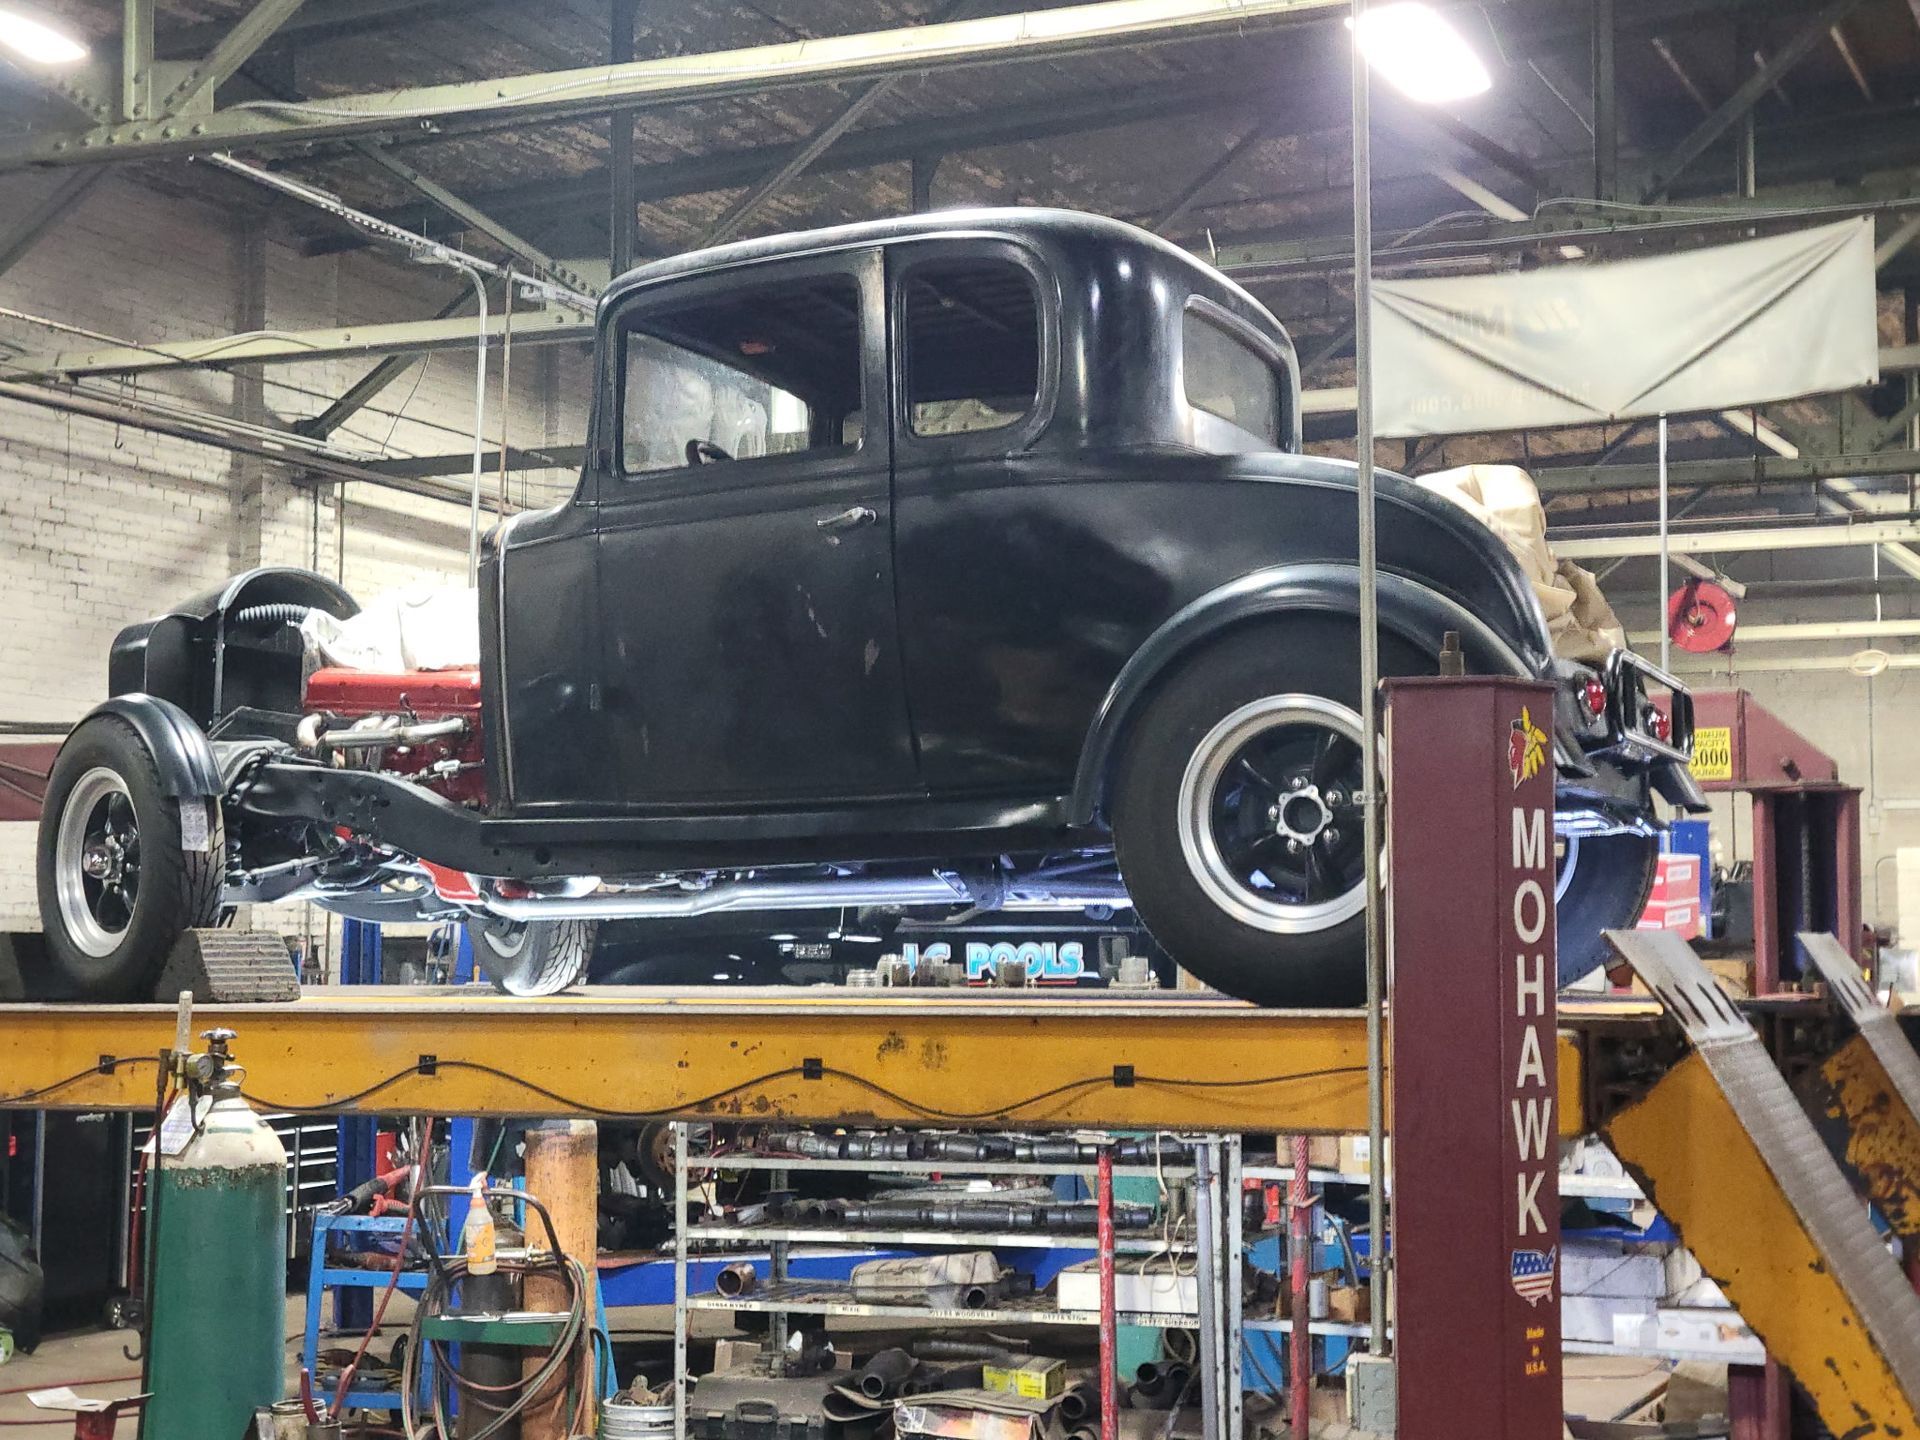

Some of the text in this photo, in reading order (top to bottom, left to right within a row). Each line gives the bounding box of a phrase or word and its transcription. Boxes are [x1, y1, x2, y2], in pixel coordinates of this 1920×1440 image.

[1690, 767, 1726, 776] OUNDS
[965, 942, 1084, 979] POOLS
[1512, 806, 1552, 1237] MOHAWK
